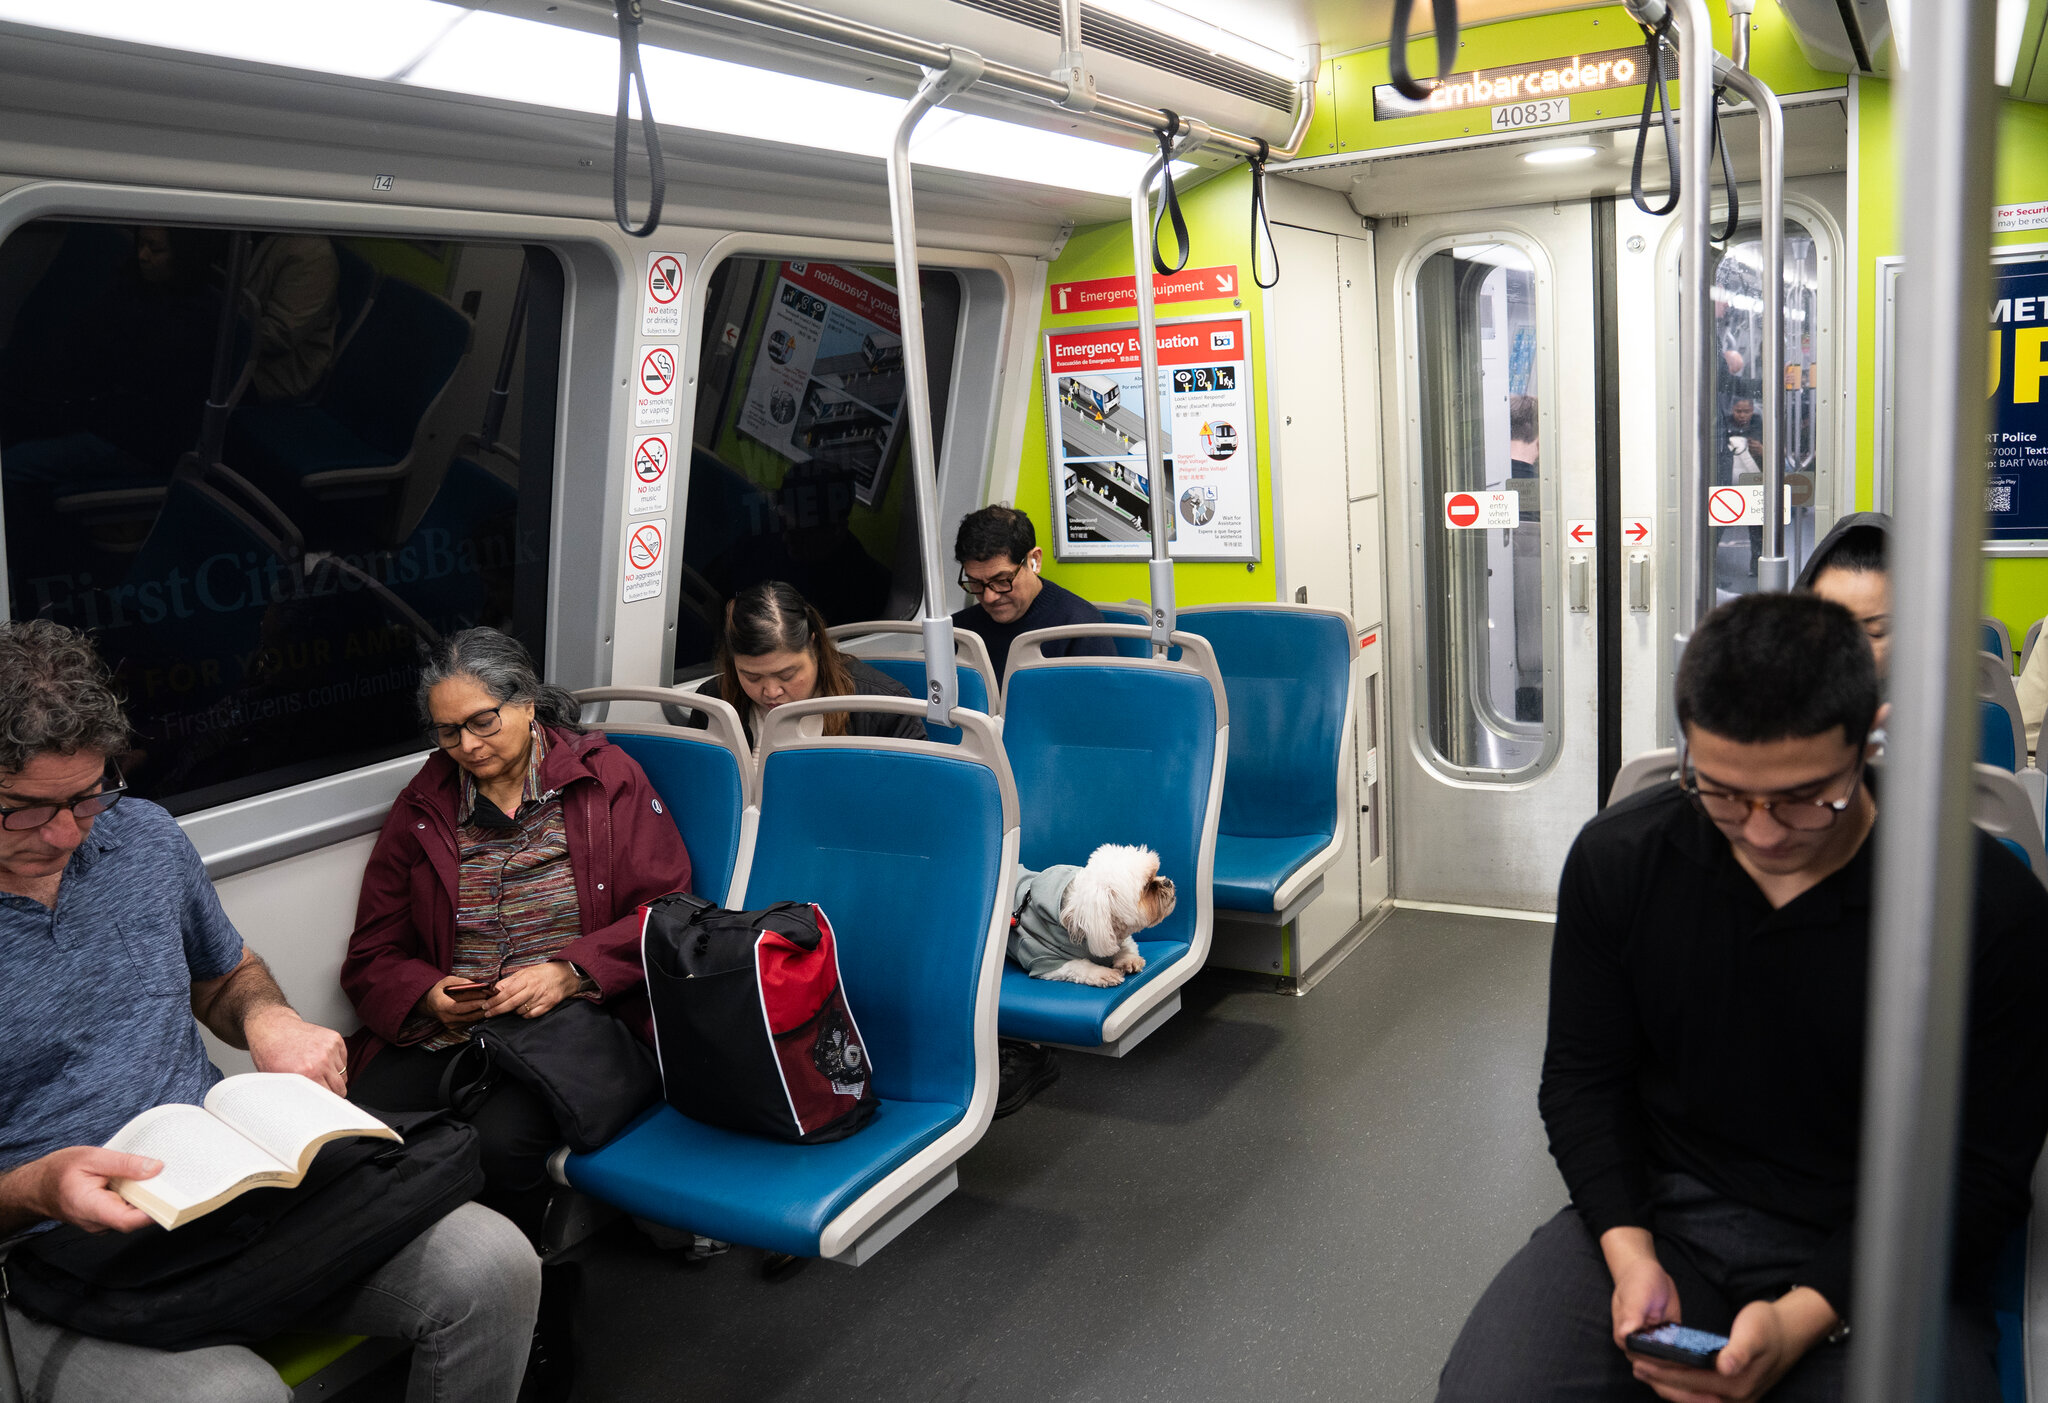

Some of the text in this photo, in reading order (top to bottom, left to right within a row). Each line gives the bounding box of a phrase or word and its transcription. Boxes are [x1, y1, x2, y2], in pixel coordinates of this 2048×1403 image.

[375, 176, 392, 189] 14
[2016, 205, 2048, 216] Securit
[1997, 220, 2016, 228] may
[1080, 288, 1138, 303] Emergency
[659, 307, 678, 316] eating
[654, 316, 678, 326] drinking
[1055, 334, 1199, 357] Emergency Evuation
[649, 398, 673, 406] smoking
[649, 407, 669, 415] vaping
[2002, 432, 2037, 443] Police
[1999, 458, 2024, 468] BART
[638, 484, 661, 494] NO loud
[625, 570, 661, 582] NO aggressive
[626, 579, 660, 592] panhandling
